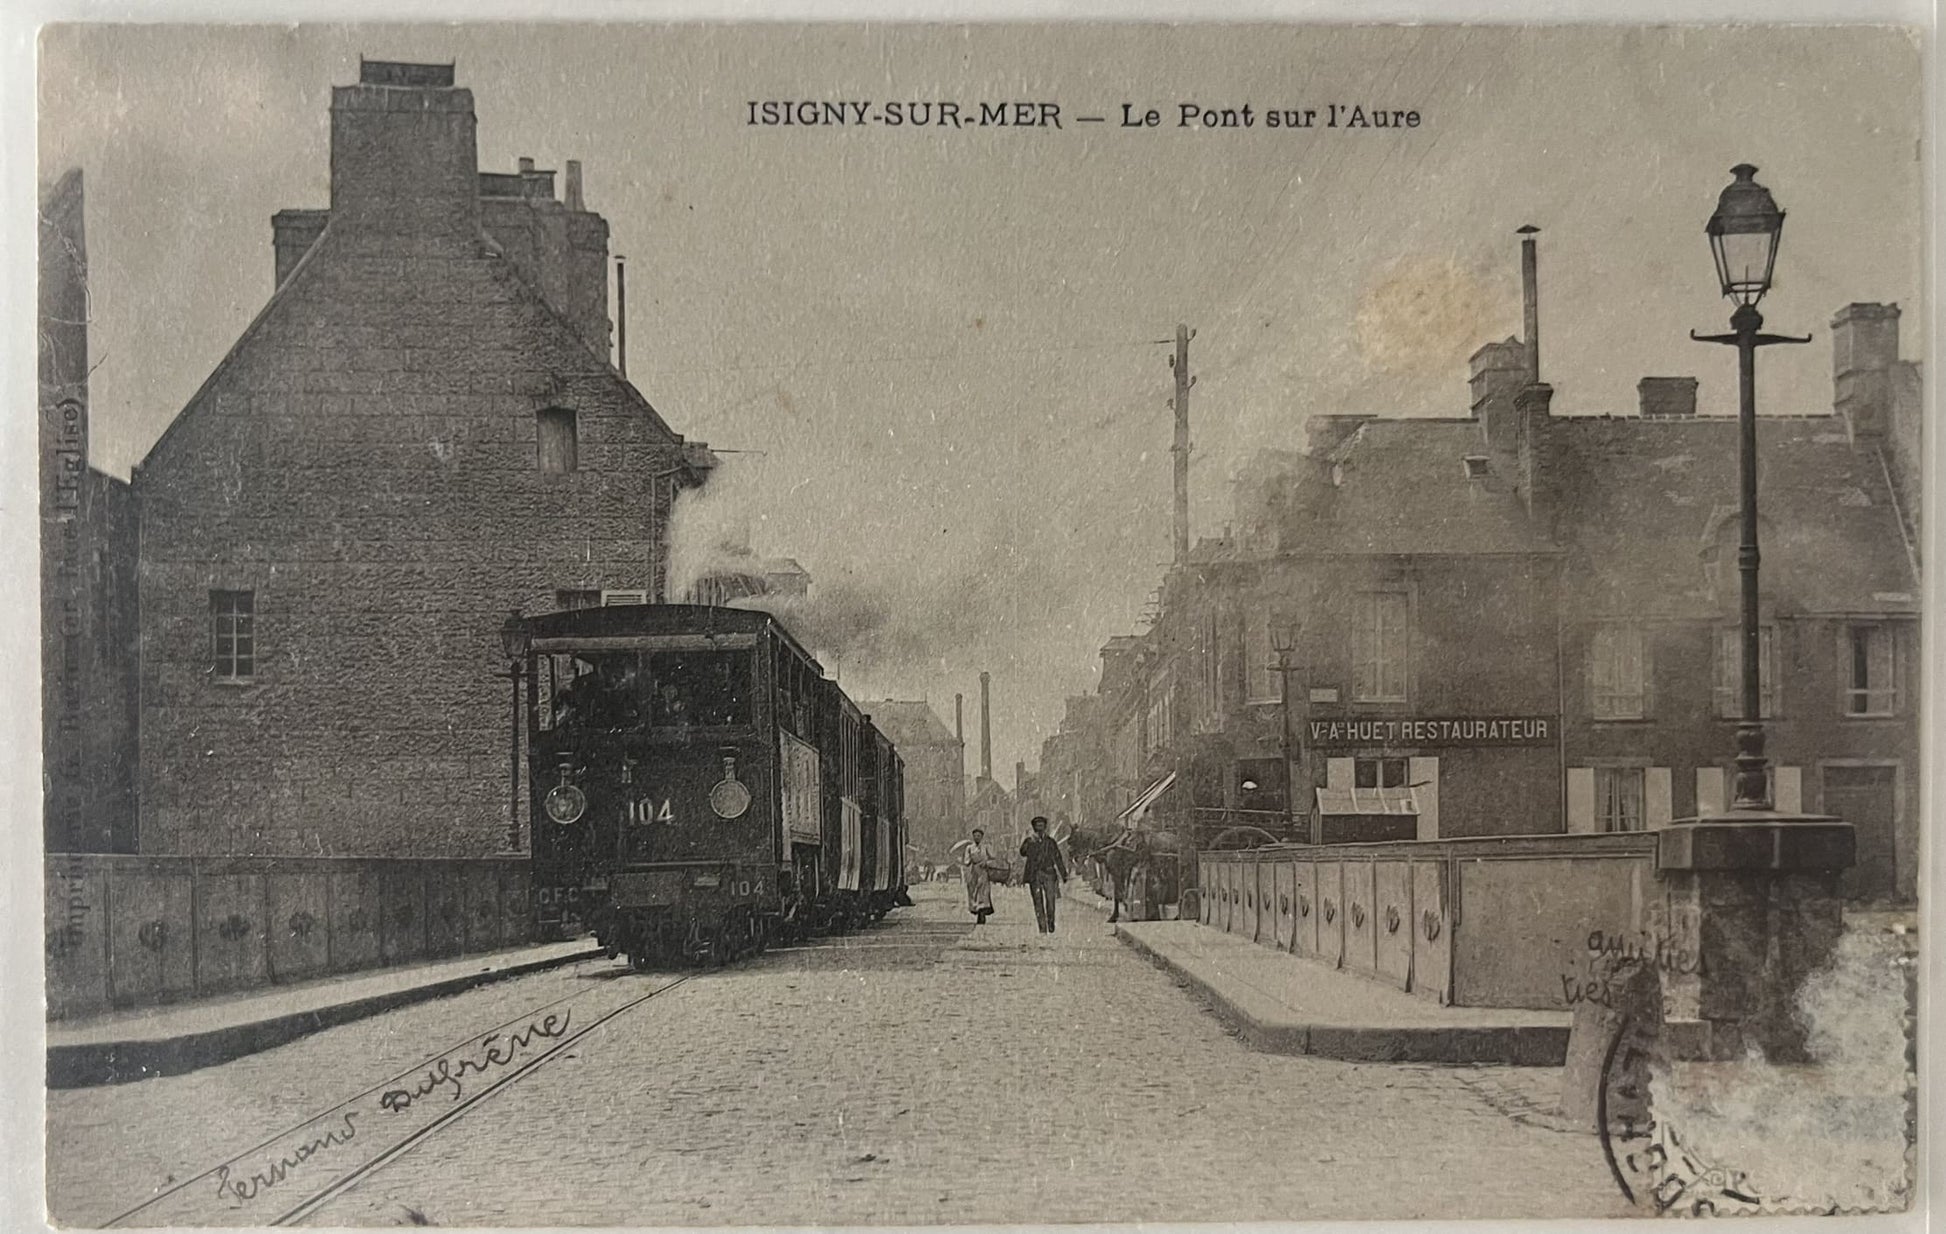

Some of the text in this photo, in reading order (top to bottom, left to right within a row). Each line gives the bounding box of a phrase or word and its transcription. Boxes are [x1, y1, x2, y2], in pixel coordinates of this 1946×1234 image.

[1347, 721, 1396, 740] HUET
[1401, 719, 1548, 739] RESTAURATEUR
[628, 799, 674, 825] 104
[730, 880, 765, 896] 104
